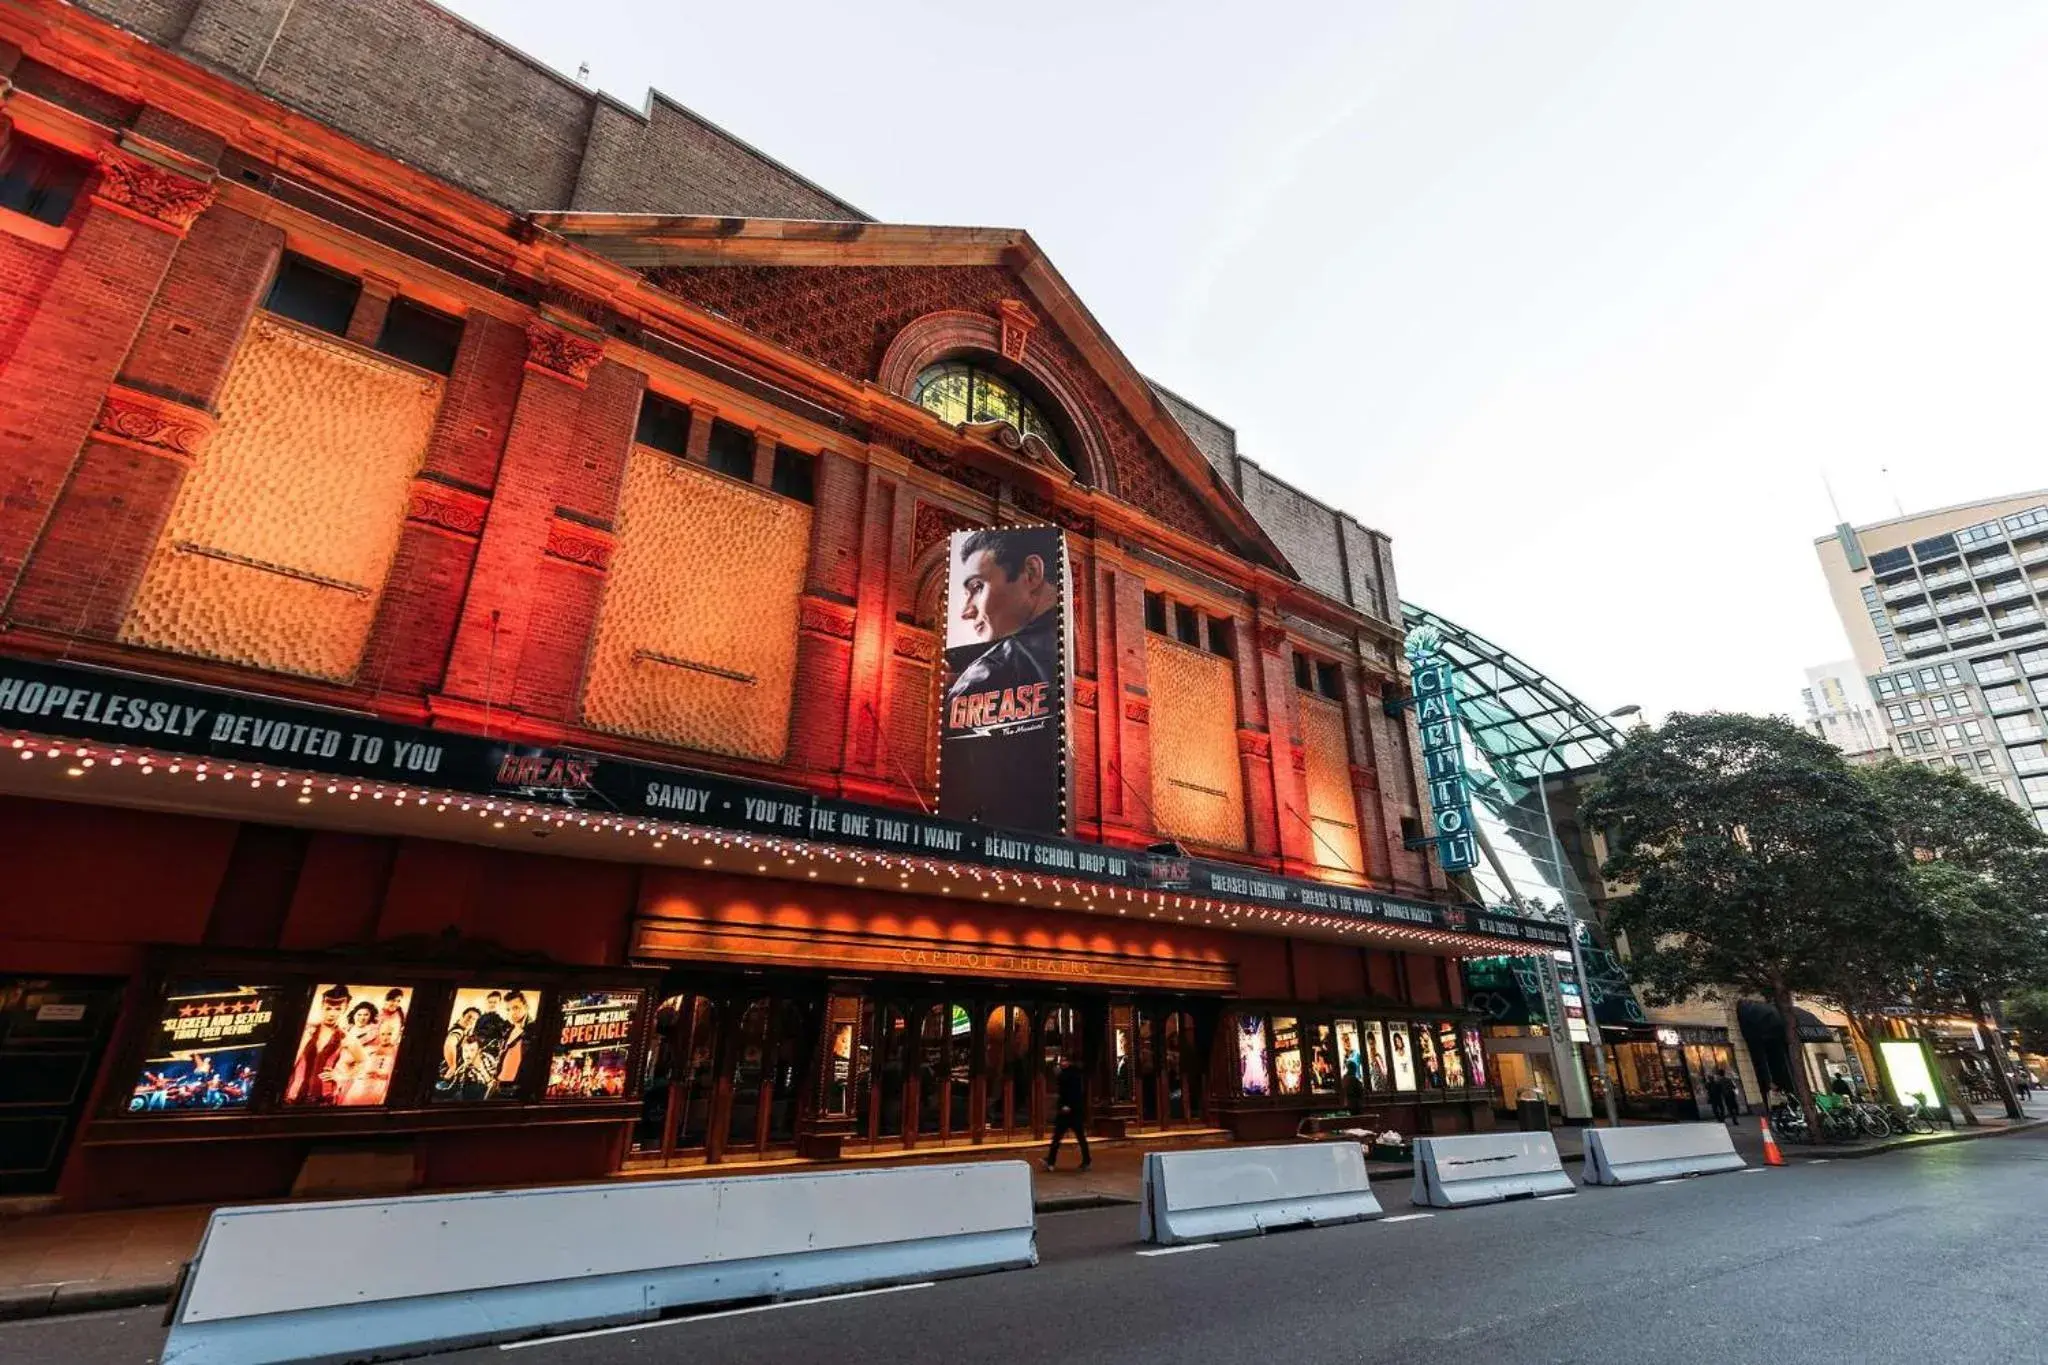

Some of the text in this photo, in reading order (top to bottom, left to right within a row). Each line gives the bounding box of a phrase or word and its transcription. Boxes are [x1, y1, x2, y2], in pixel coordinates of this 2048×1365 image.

[0, 677, 443, 773] HOPELESSLY DEVOTED TO YOU
[950, 681, 1050, 729] GREASE
[496, 752, 600, 787] GREASE
[1417, 670, 1466, 863] CAPITOL
[645, 781, 1127, 877] SANDY YOU'RE THE ONE THAT I WANT BEAUTY SCHOOL DROP OUT
[901, 949, 1090, 974] CAPITOL THEATRE
[211, 1014, 234, 1026] AND
[561, 1020, 633, 1045] SPECTACLE"
